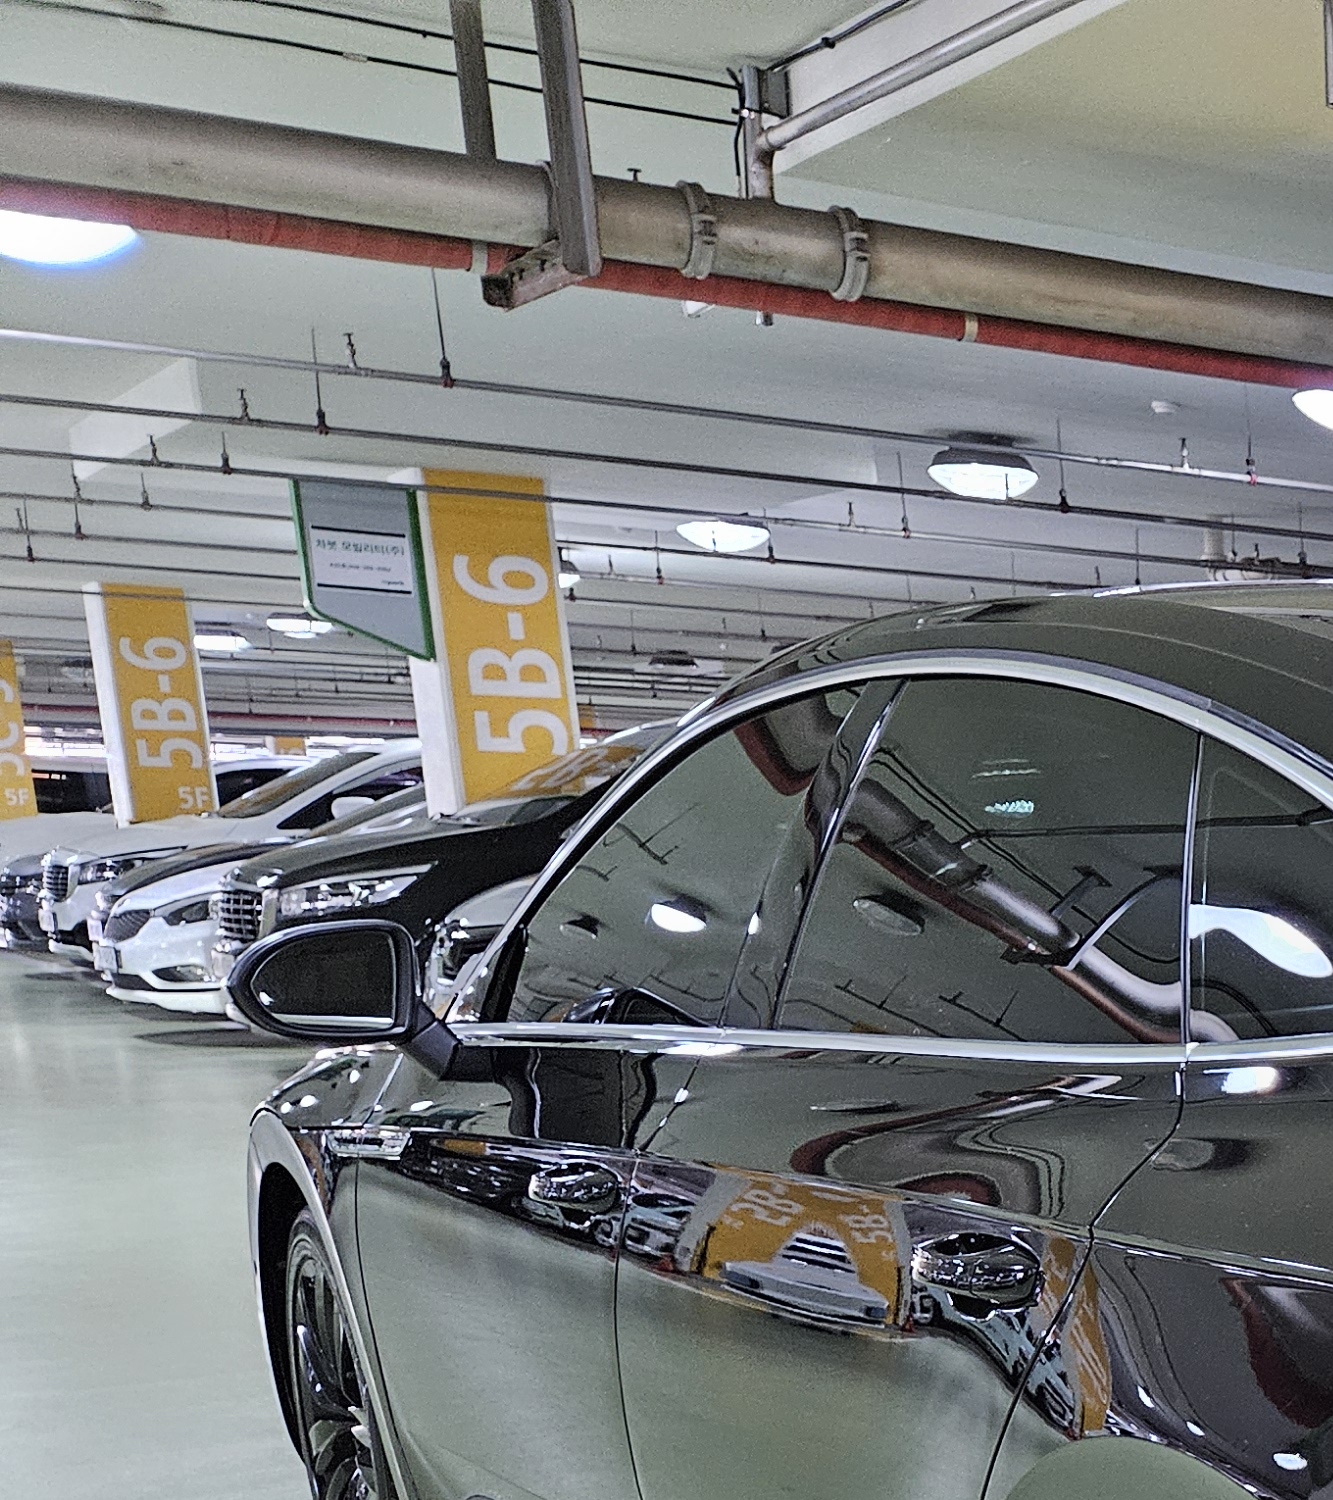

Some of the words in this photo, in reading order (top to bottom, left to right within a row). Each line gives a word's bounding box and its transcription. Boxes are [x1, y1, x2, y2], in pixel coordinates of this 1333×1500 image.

[453, 554, 568, 755] 5B-6
[119, 636, 204, 769] 5B-6
[4, 787, 30, 806] 5F
[178, 786, 210, 809] 5F
